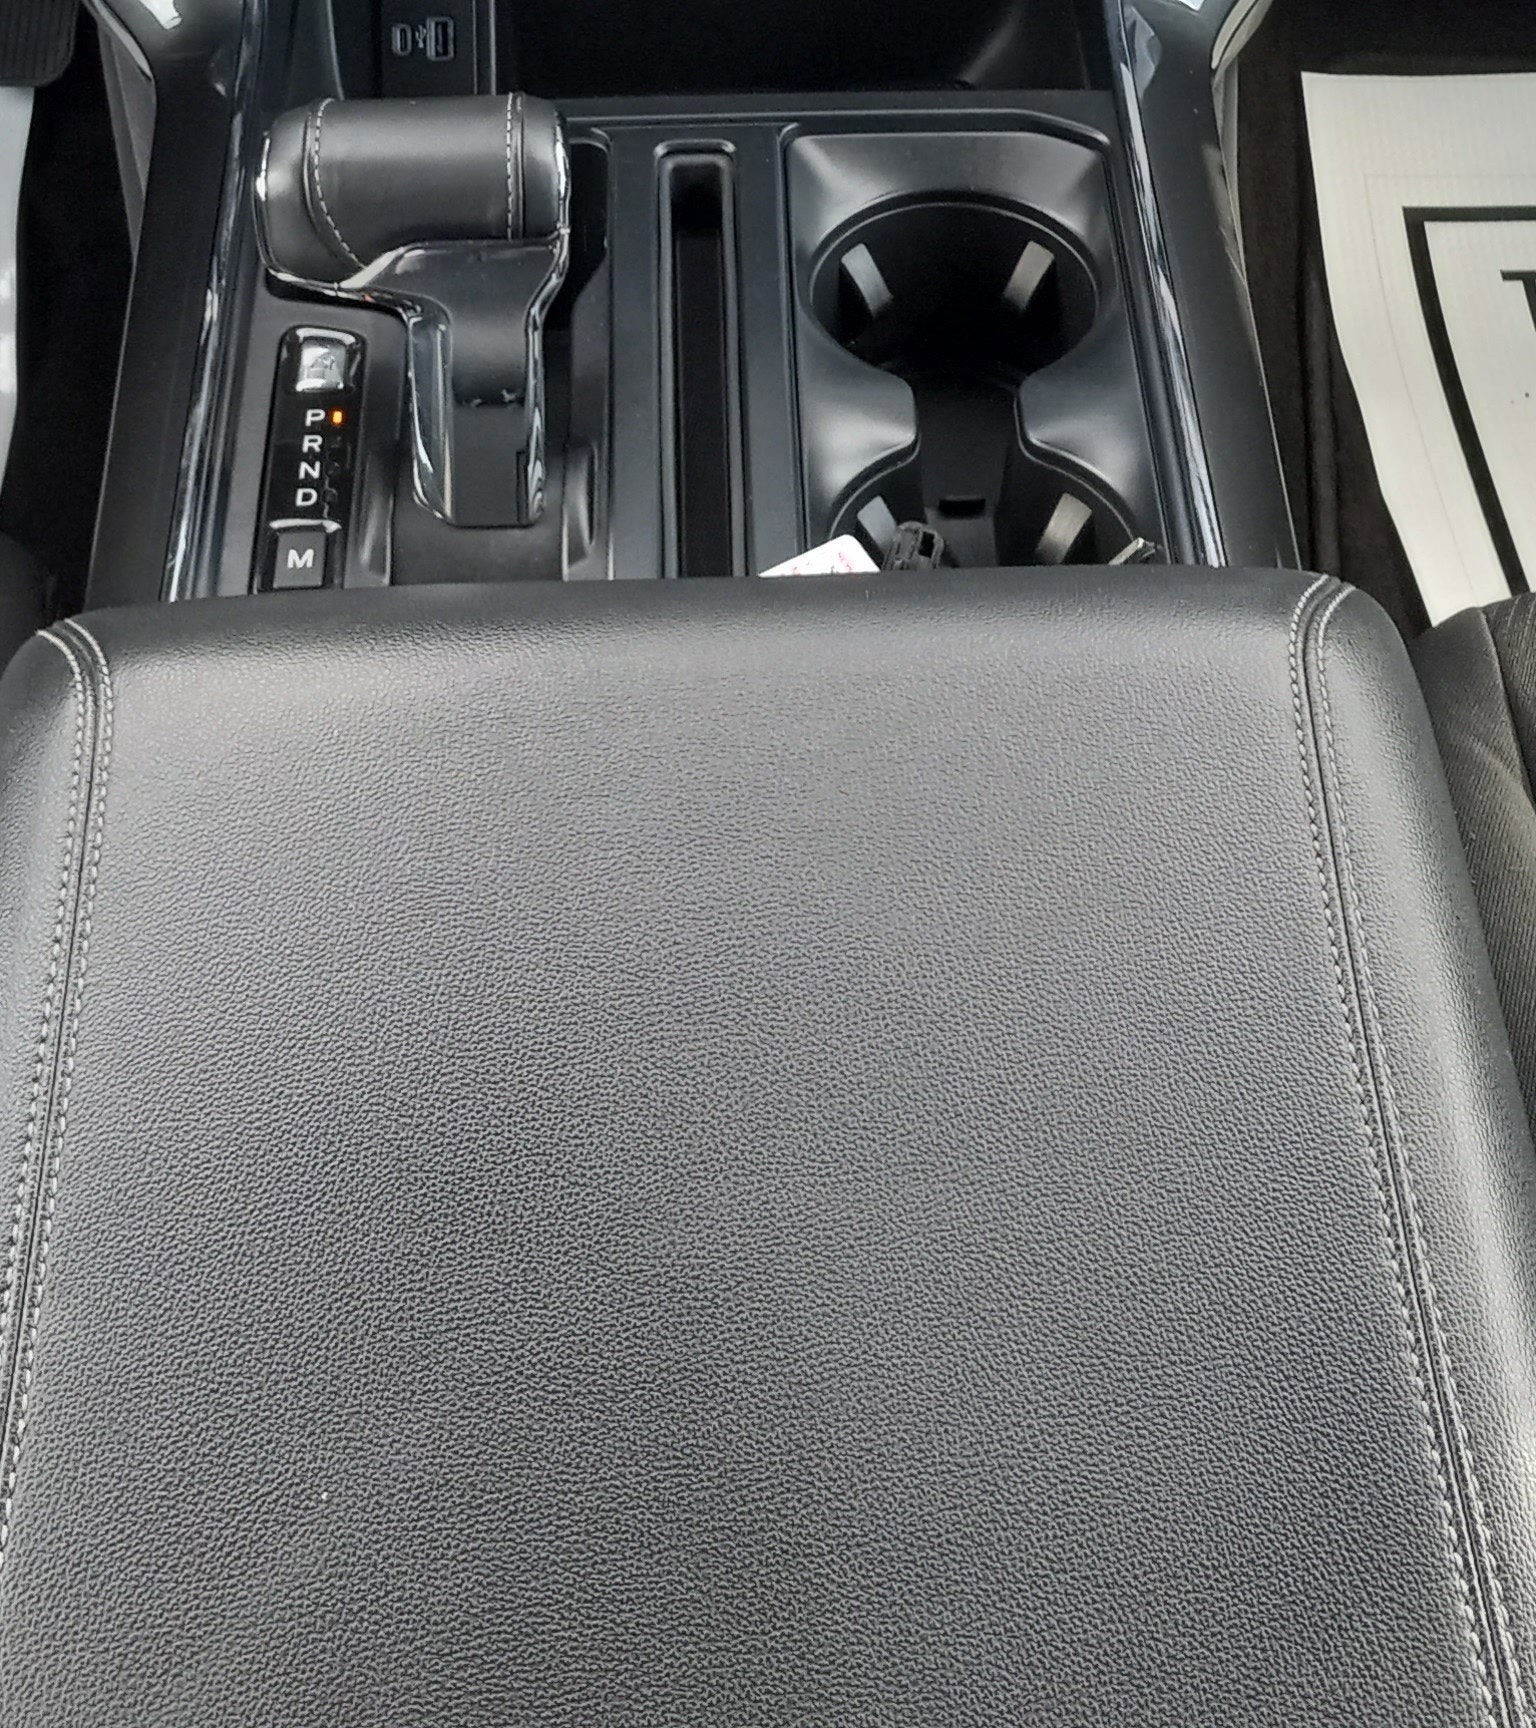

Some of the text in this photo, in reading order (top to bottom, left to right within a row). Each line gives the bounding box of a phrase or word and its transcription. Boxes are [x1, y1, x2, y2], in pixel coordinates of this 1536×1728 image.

[305, 409, 325, 426] P
[302, 434, 323, 452] R
[299, 461, 321, 480] N
[296, 488, 317, 506] D
[287, 549, 313, 568] M
